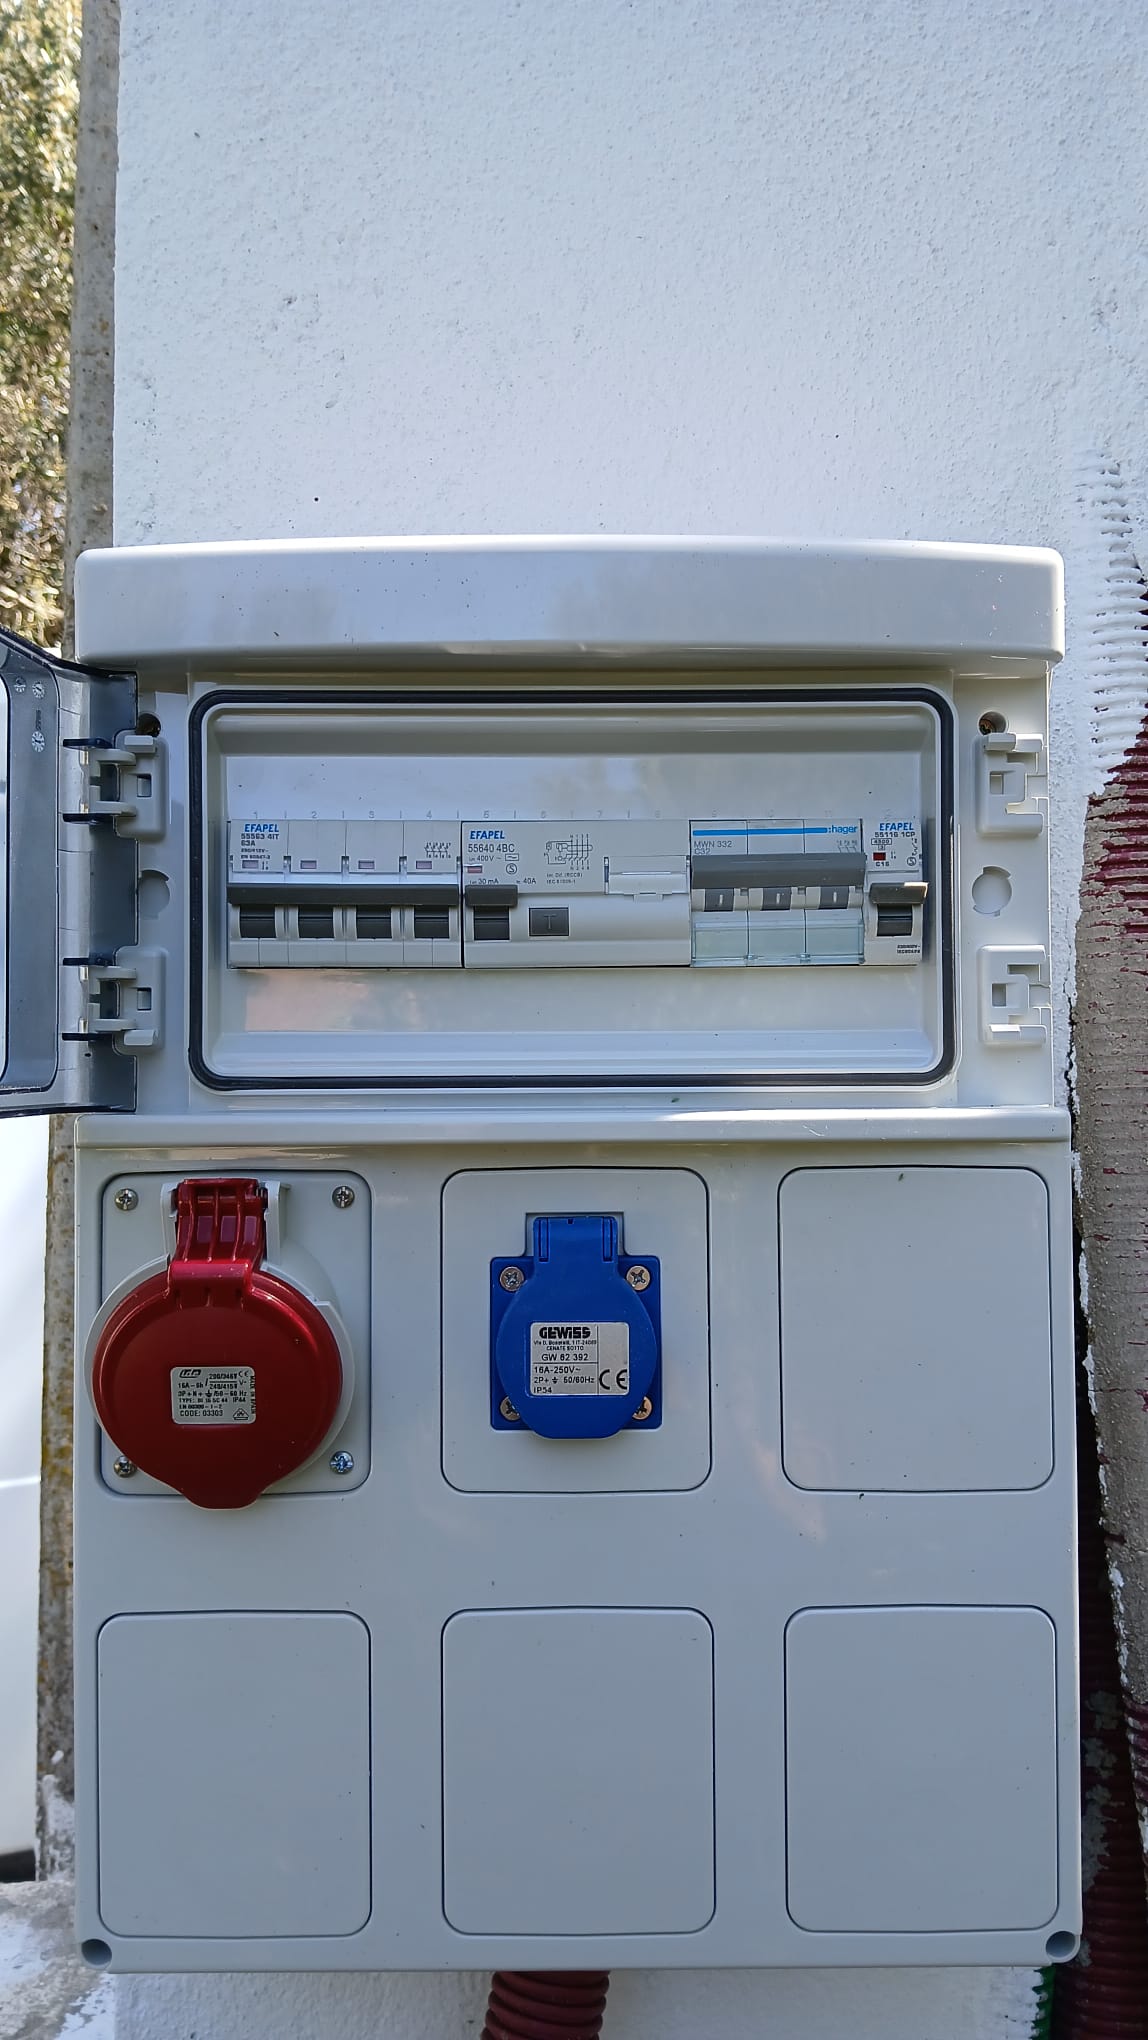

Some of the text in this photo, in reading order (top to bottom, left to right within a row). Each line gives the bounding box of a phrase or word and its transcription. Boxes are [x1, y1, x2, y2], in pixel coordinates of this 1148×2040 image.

[244, 823, 280, 833] EFAPEL
[879, 822, 914, 831] EFAPEL
[469, 830, 506, 840] EFAPEL
[467, 843, 516, 853] 55640 4BC
[693, 840, 733, 848] MWN 332
[693, 847, 711, 855] C32
[541, 1353, 558, 1361] GW
[573, 1353, 589, 1361] 392
[533, 1386, 553, 1394] IP54
